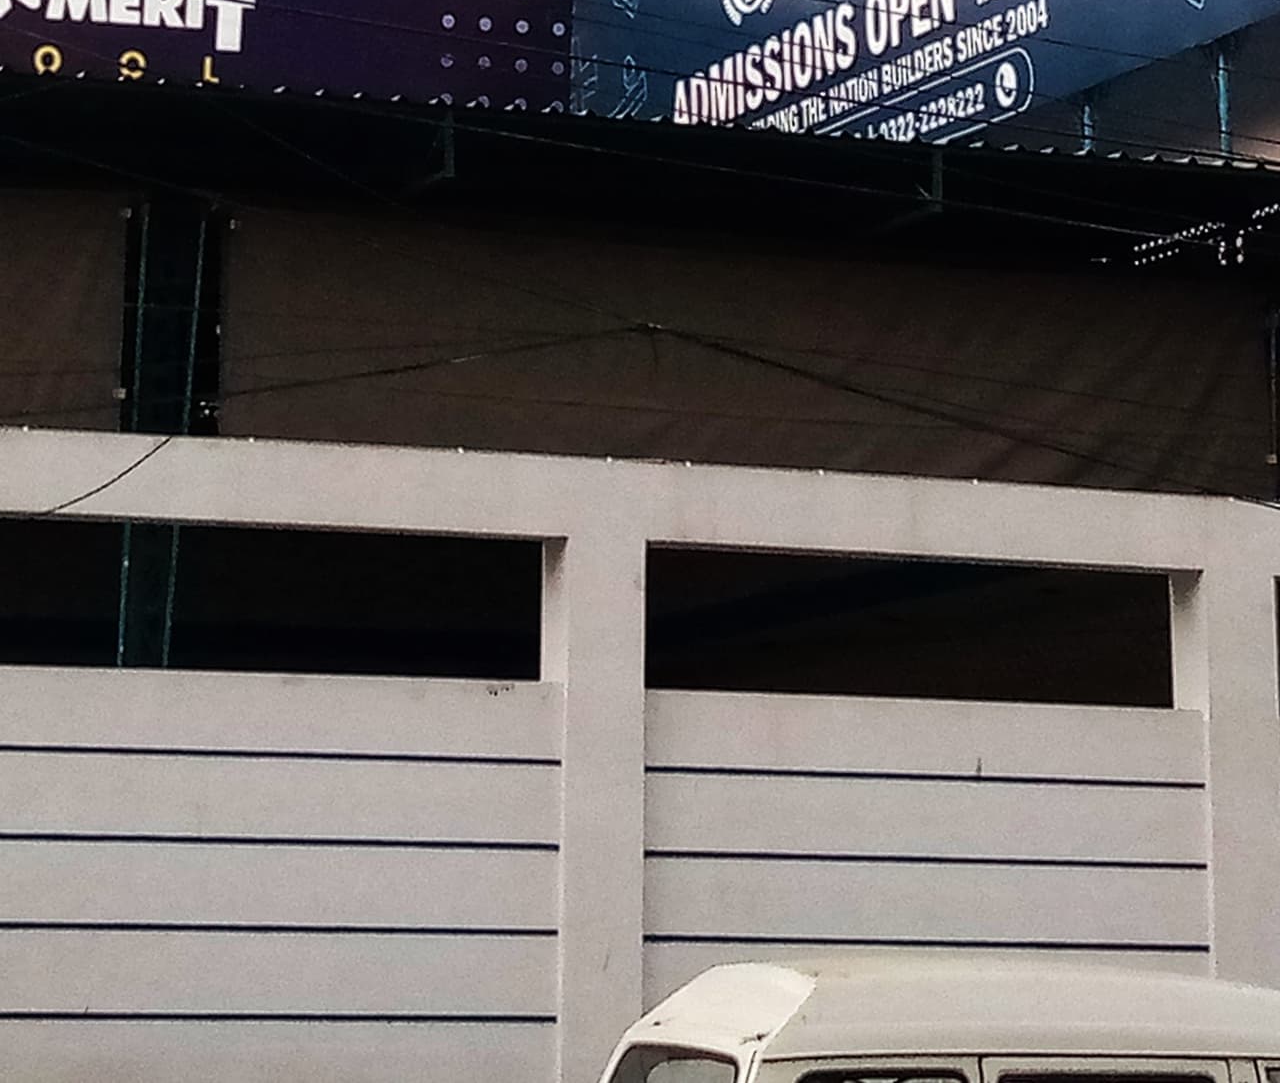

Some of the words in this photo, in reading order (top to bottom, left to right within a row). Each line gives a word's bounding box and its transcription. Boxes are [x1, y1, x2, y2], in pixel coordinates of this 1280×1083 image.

[673, 3, 856, 127] ADMISSIONS
[800, 92, 827, 130] THE
[829, 71, 878, 117] NATION
[881, 37, 953, 94] BUILDERS
[956, 14, 1004, 63] SINCE
